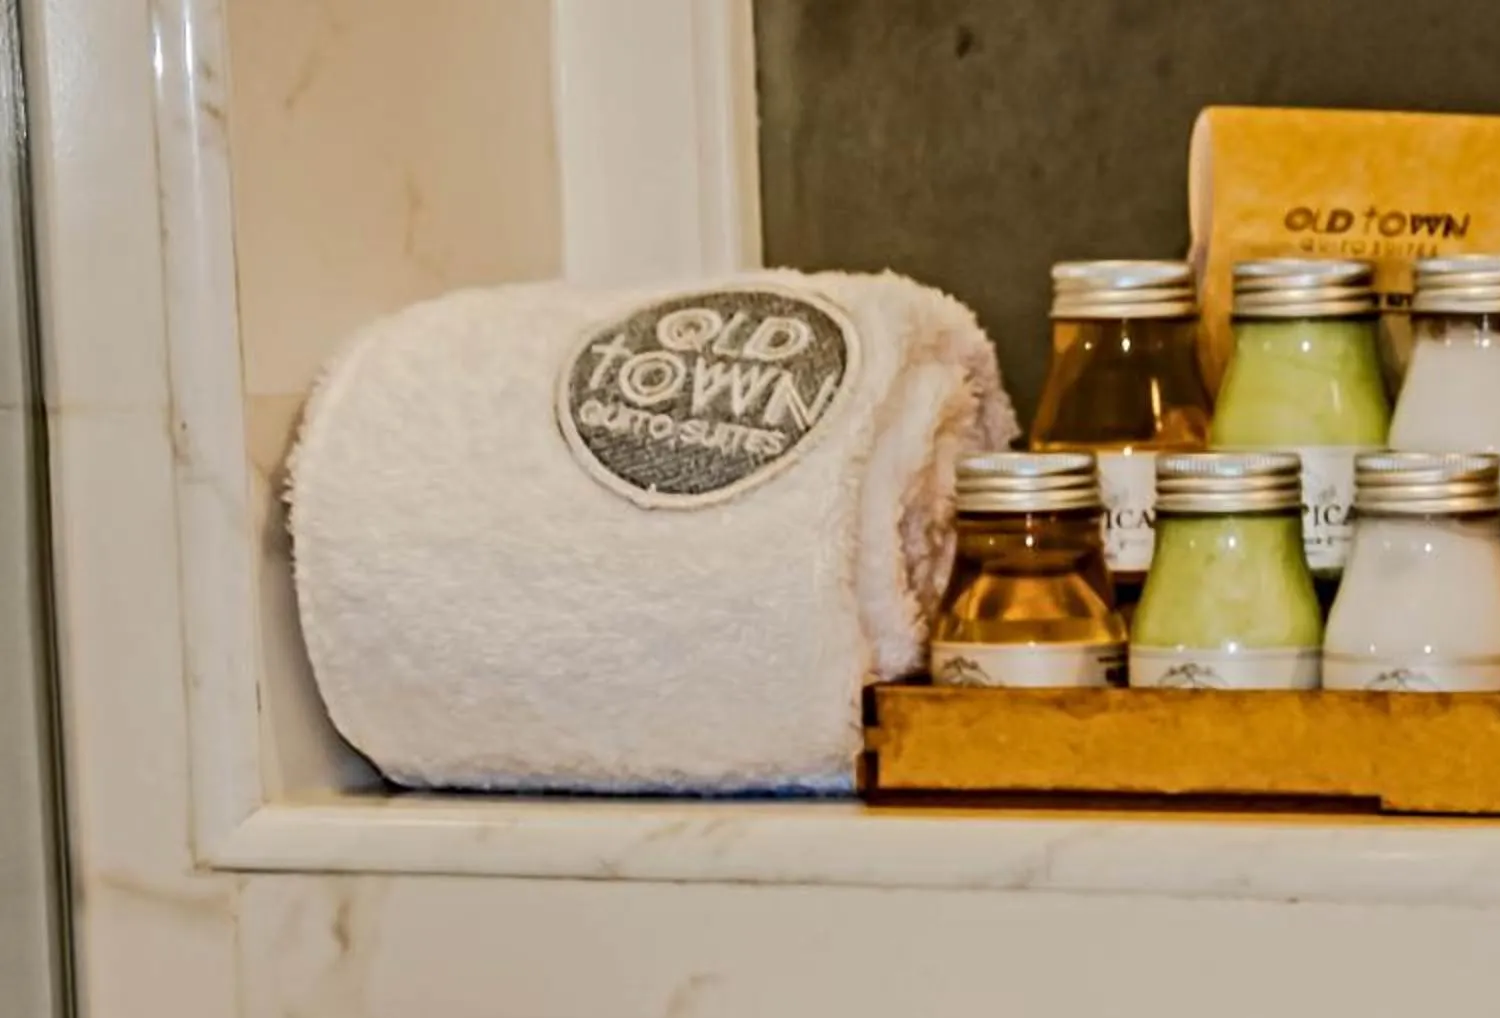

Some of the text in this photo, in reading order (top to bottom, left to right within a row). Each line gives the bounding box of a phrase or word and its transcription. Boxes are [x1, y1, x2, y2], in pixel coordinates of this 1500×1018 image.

[1284, 206, 1356, 234] OLD
[657, 307, 814, 361] OLD
[678, 419, 787, 456] SUITES
